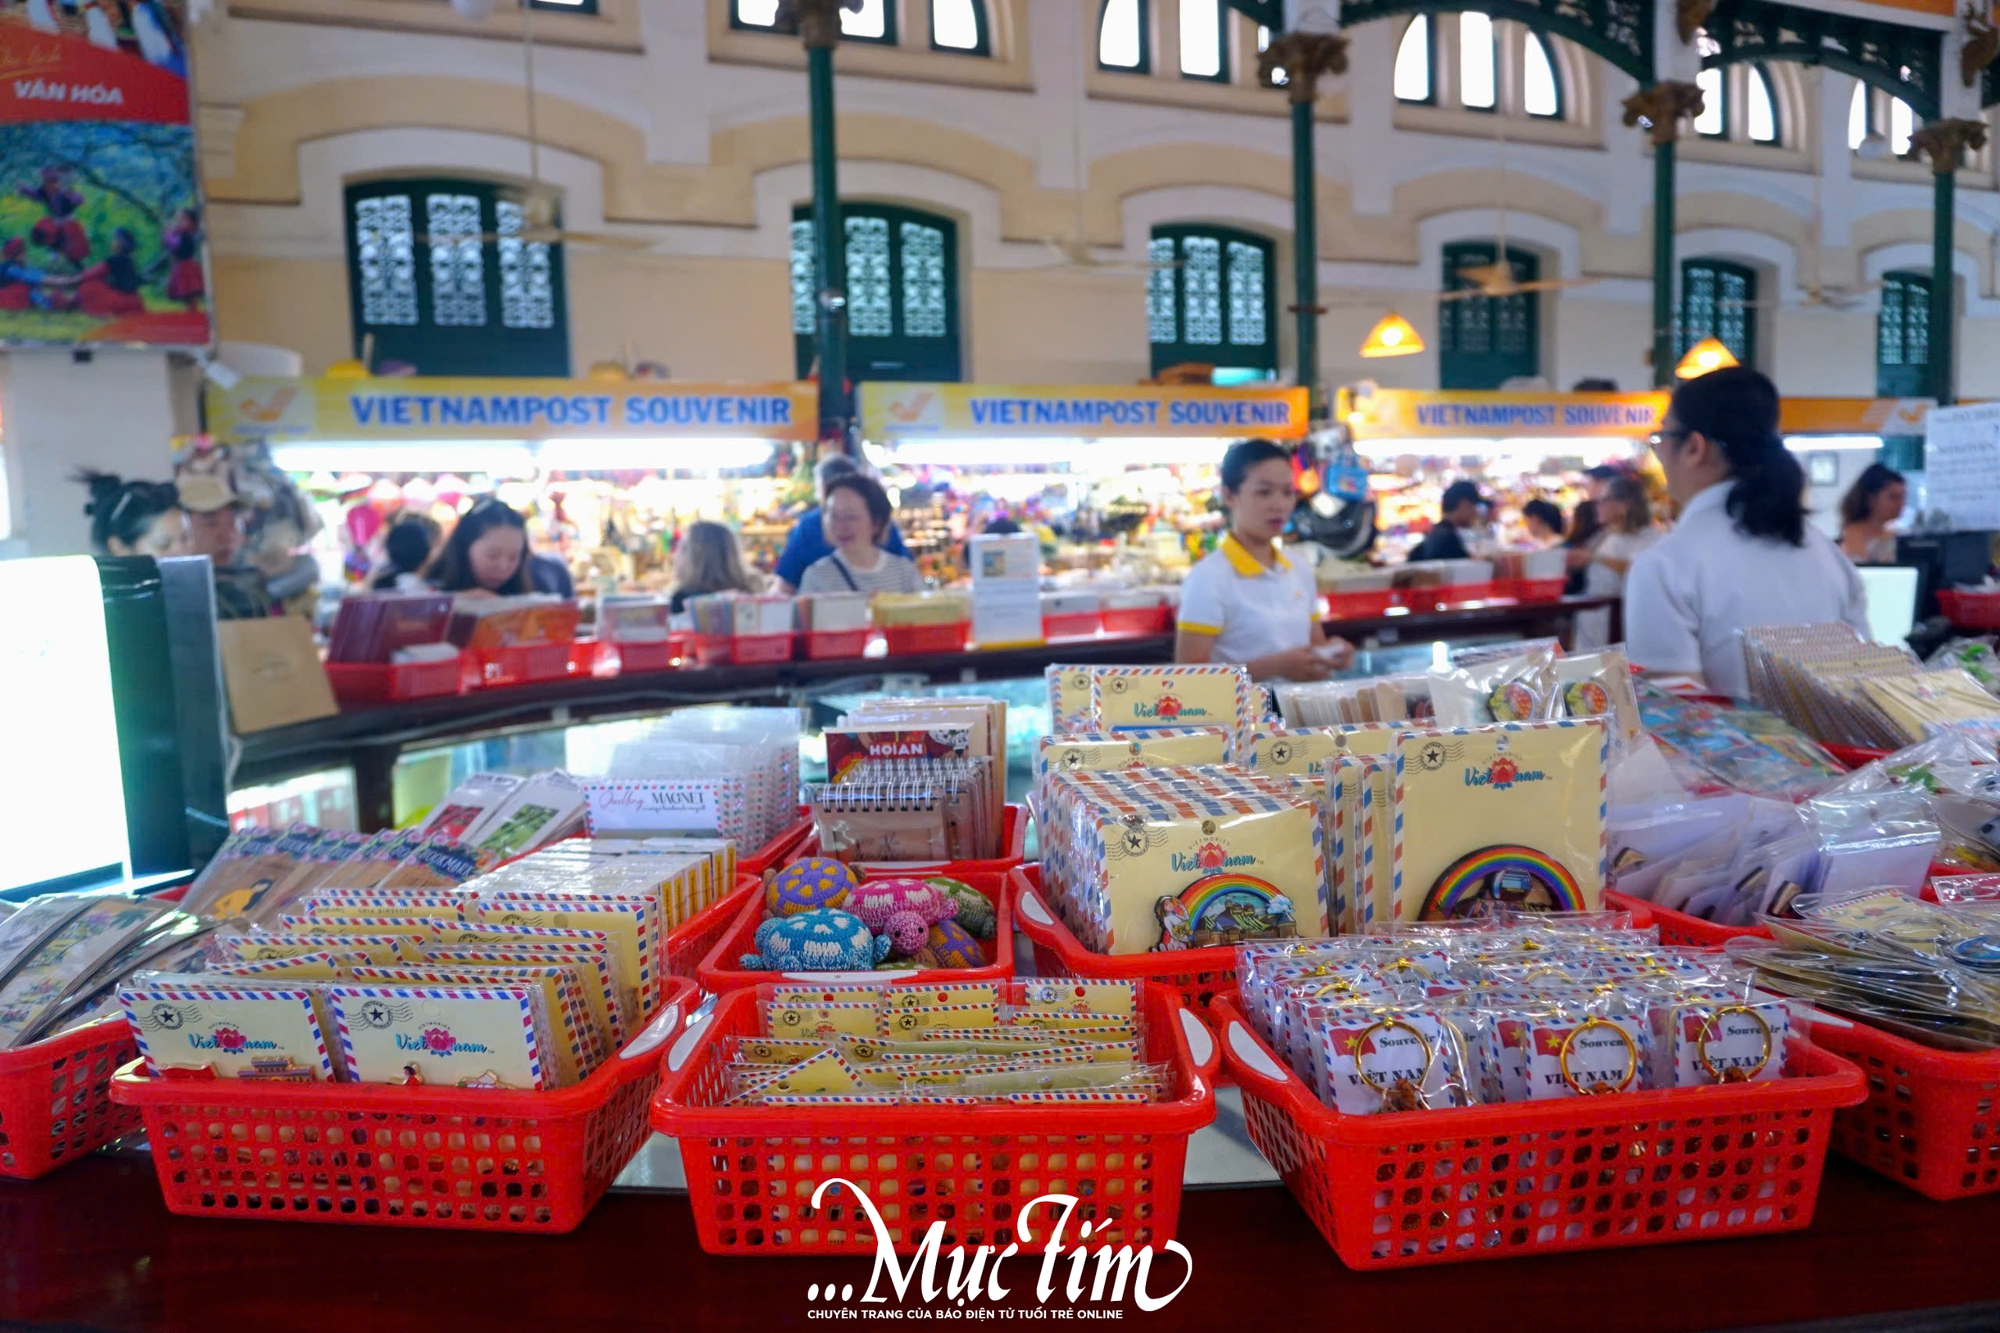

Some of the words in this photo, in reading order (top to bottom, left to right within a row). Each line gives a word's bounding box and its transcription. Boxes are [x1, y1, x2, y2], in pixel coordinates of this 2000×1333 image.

[350, 395, 612, 425] VIETNAMPOST
[624, 395, 792, 425] SOUVENIR
[970, 397, 1160, 426] VIETNAMPOST
[1169, 399, 1290, 426] SOUVENIR
[1416, 403, 1557, 426] VIETNAMPOST
[651, 791, 705, 805] MAGNET
[1726, 1023, 1781, 1037] Souveir
[1380, 1033, 1435, 1049] Souveir
[1580, 1037, 1636, 1049] Souven
[1586, 1069, 1624, 1083] NAM
